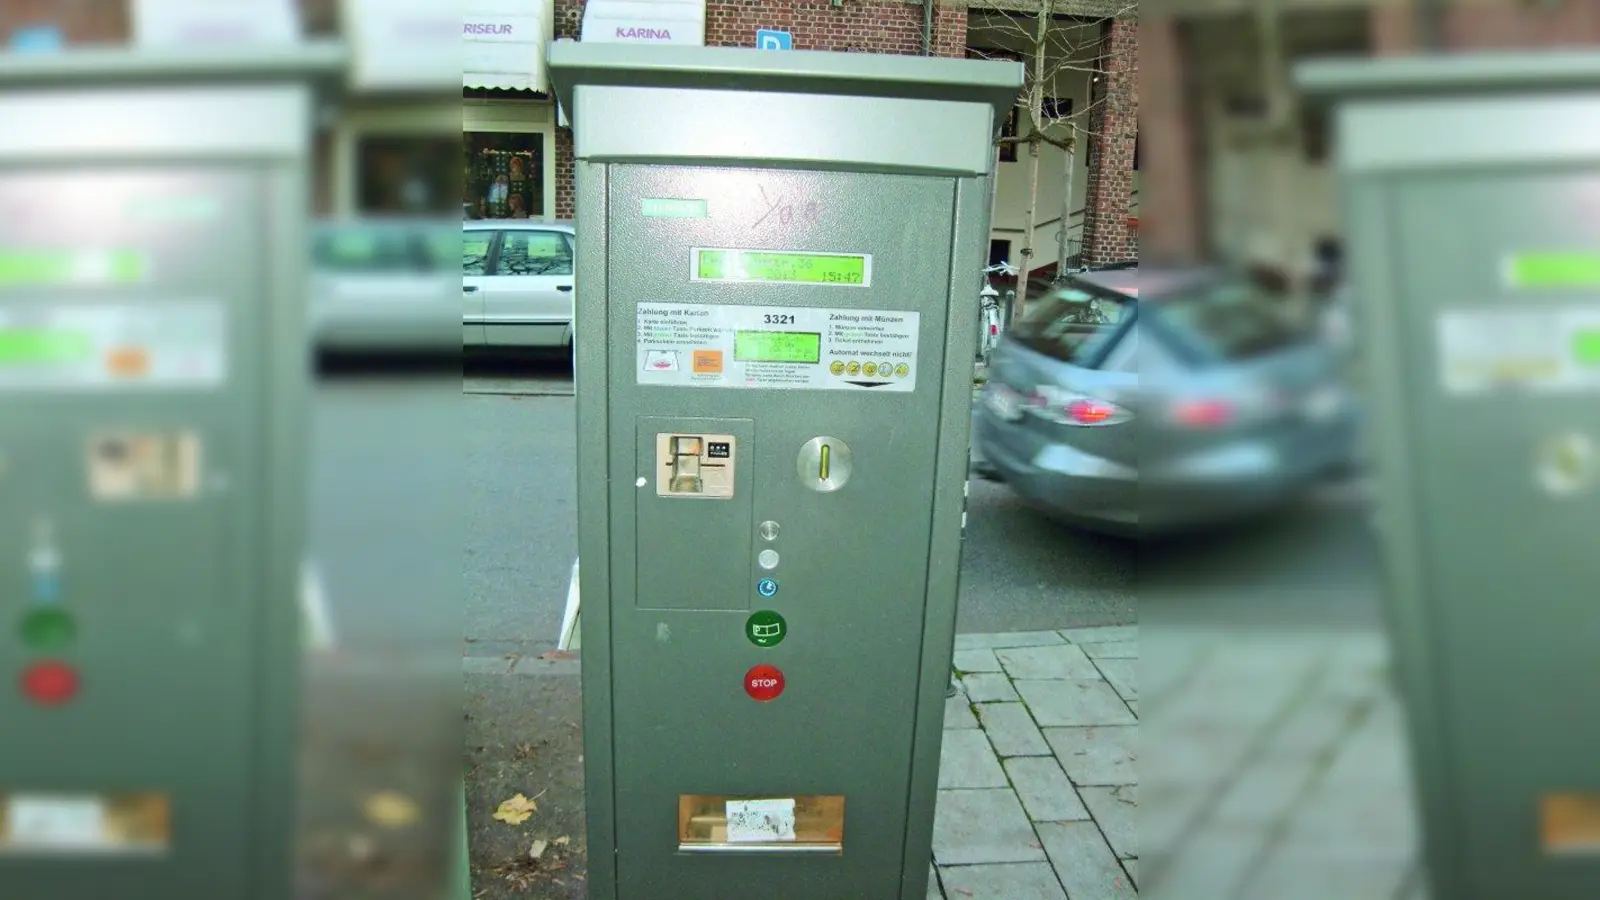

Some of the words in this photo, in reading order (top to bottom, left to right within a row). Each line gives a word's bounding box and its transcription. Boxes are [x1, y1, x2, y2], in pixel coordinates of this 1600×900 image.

[463, 23, 512, 35] RISEUR
[616, 27, 672, 41] KARINA
[821, 271, 860, 283] 15:47
[637, 308, 669, 317] Zahlung
[670, 308, 682, 316] mit
[764, 314, 796, 325] 3321
[829, 313, 860, 322] Zahlung
[874, 315, 904, 323] Münzen
[829, 349, 859, 357] Automat
[860, 350, 891, 358] wechselt
[751, 679, 777, 688] STOP
